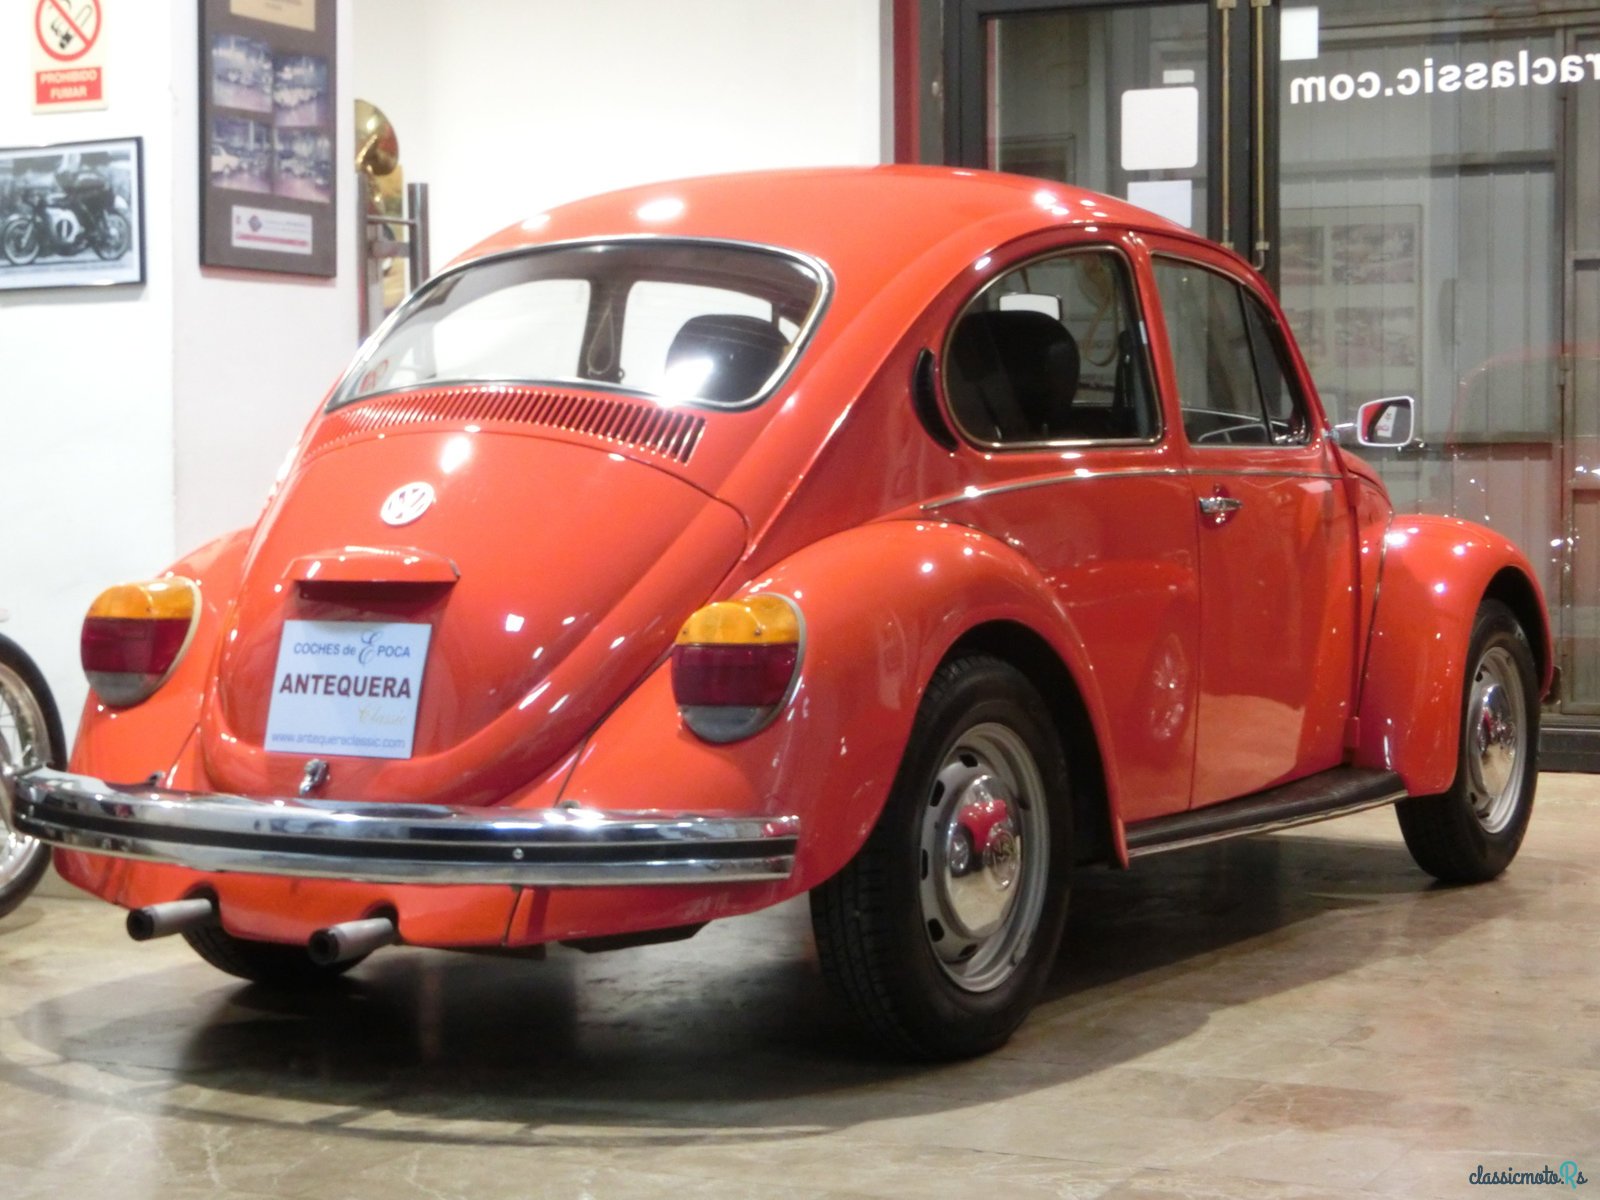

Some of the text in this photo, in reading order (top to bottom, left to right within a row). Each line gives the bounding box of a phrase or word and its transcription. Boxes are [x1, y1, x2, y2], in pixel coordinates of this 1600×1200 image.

[40, 70, 97, 84] PROHIBIDO
[50, 86, 87, 99] FUMAR
[294, 643, 340, 656] COCHES
[342, 643, 357, 656] de
[279, 673, 412, 699] ANTEQUERA
